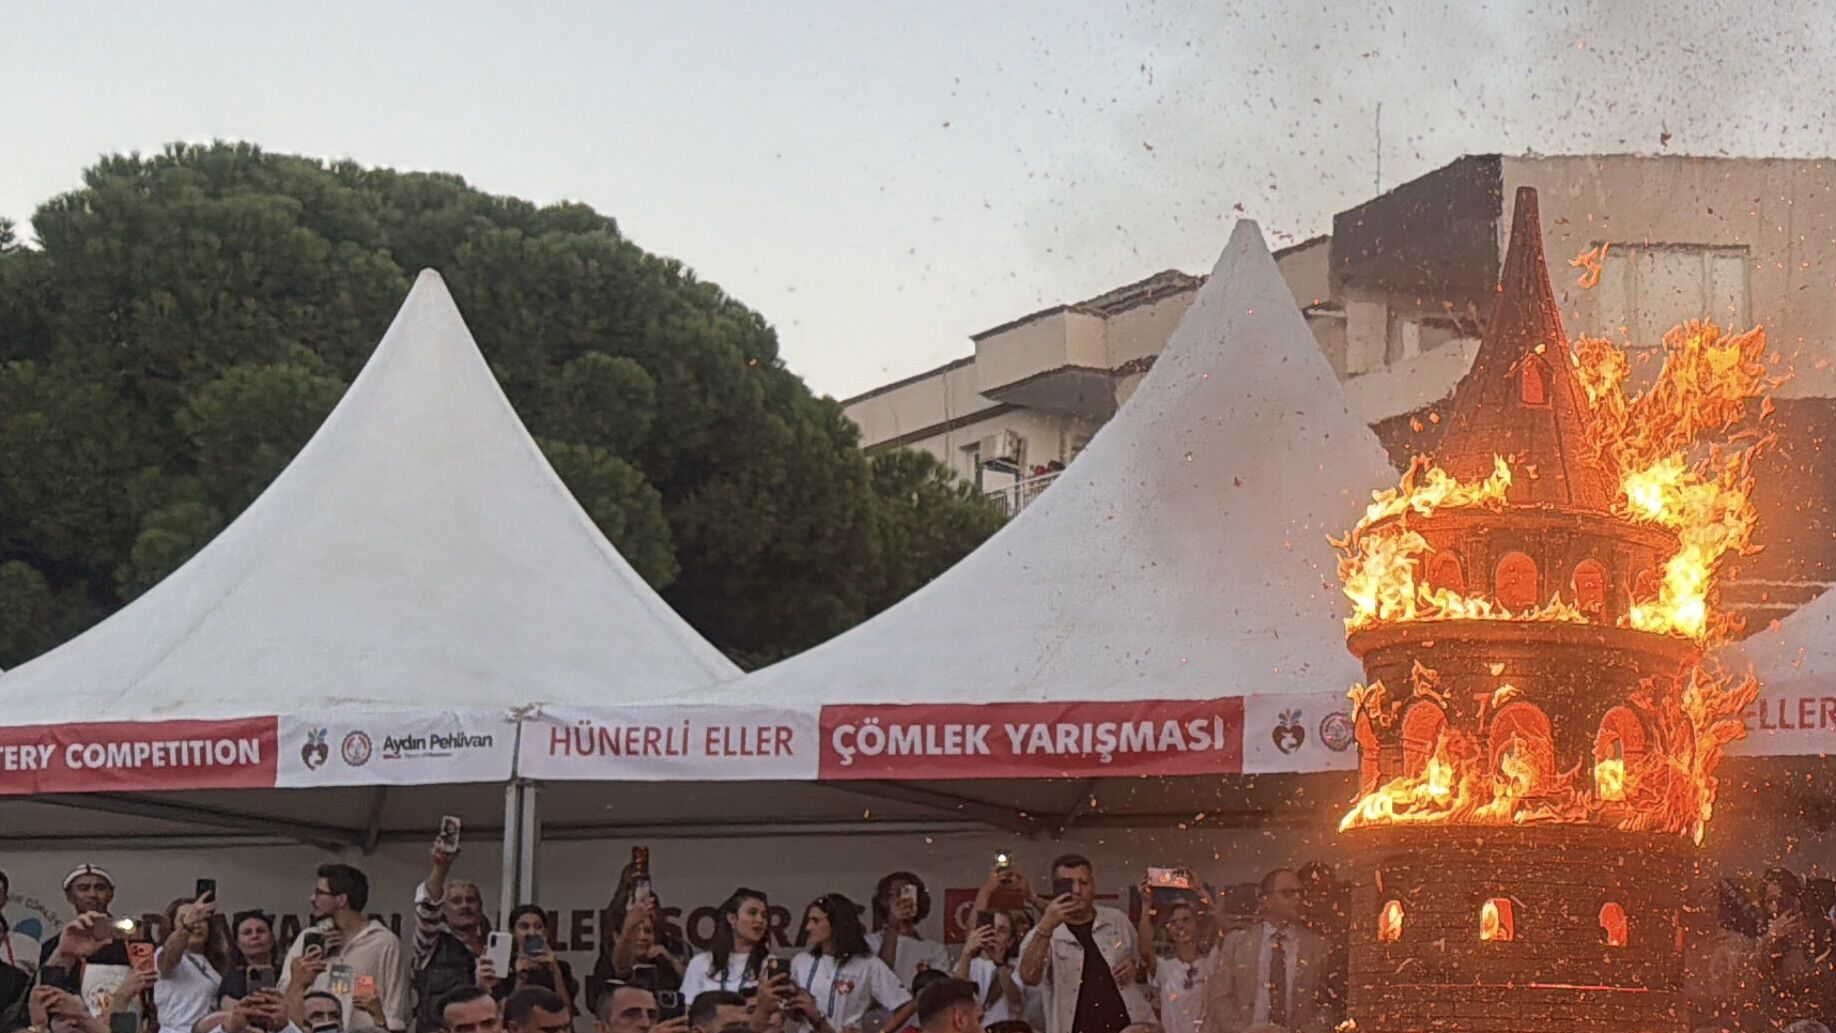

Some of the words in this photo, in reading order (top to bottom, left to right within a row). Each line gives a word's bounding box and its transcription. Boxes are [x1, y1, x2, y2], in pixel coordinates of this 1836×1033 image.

[64, 737, 261, 770] COMPETITION
[383, 734, 426, 755] Aydın
[430, 731, 493, 750] Pehlivan
[549, 719, 690, 757] HÜNERLİ
[704, 725, 795, 757] ELLER
[831, 716, 991, 765] ÇÖMLEK
